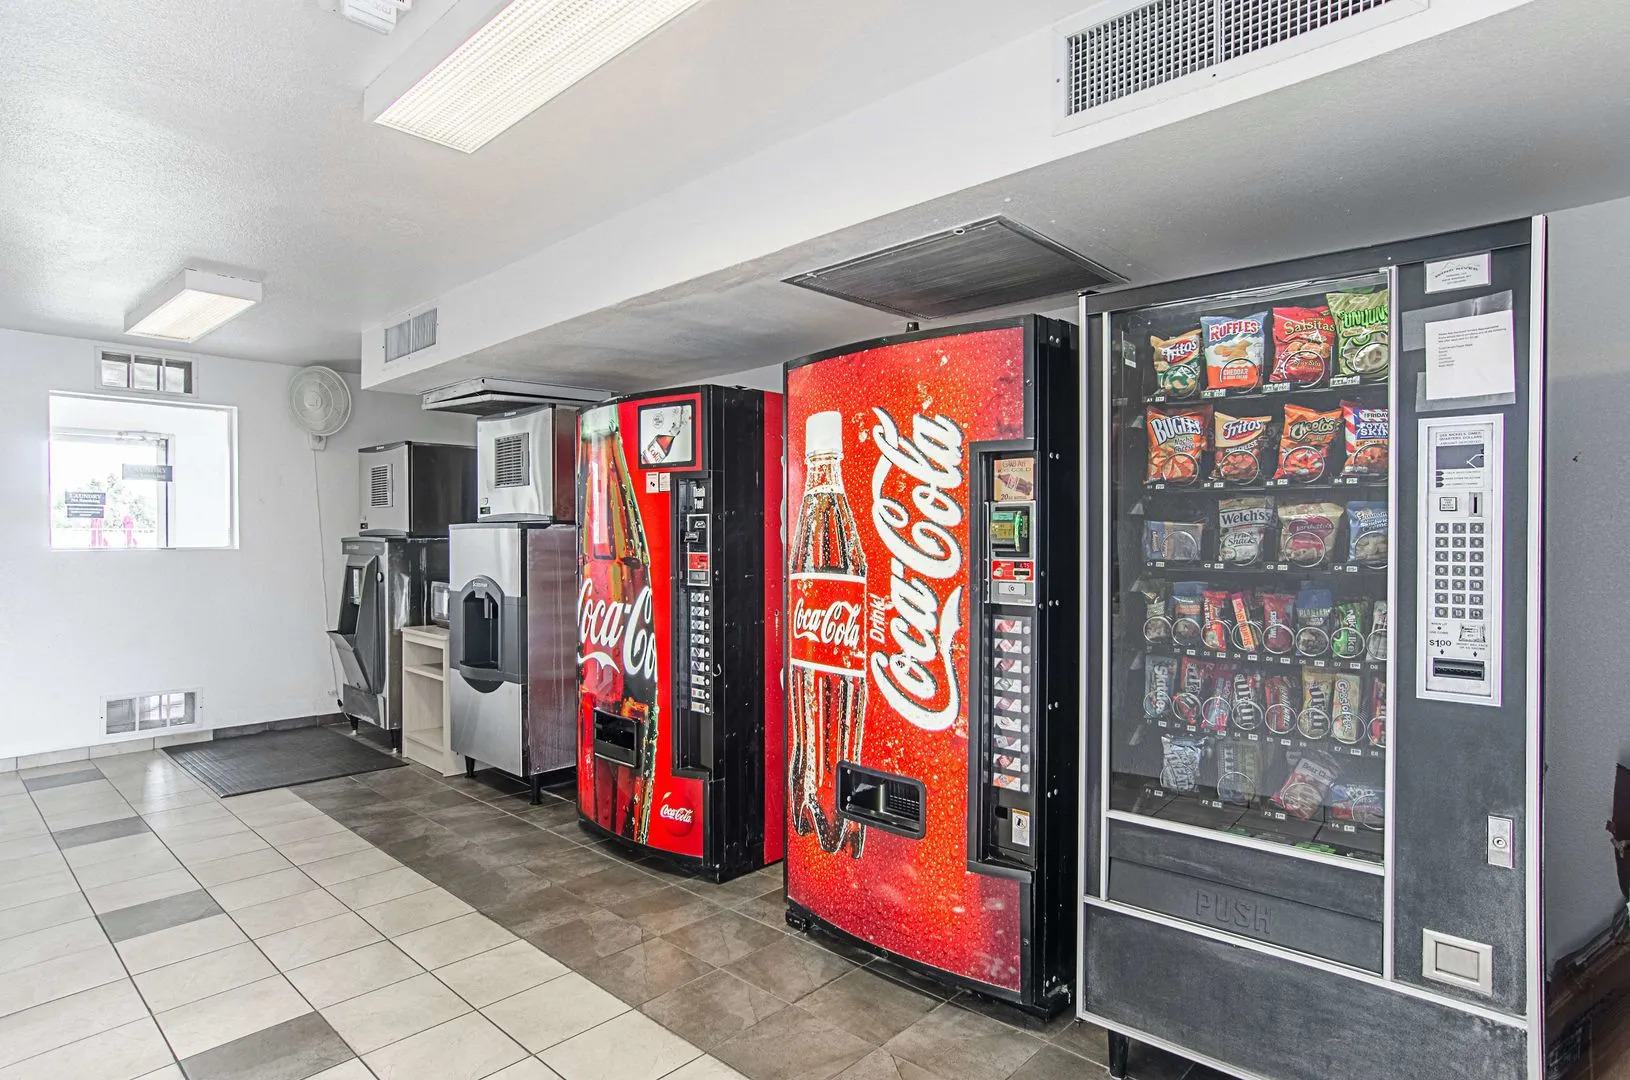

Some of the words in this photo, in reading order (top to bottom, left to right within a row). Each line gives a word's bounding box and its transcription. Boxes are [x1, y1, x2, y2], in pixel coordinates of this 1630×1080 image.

[1210, 320, 1259, 341] RUFFLES
[1283, 319, 1335, 335] Salsitas
[1162, 339, 1198, 361] Fritos
[1222, 420, 1261, 440] Fritos
[1290, 418, 1335, 441] Cheetos
[1222, 509, 1266, 525] Welch's
[871, 406, 965, 732] Coca-Cola
[793, 600, 861, 650] Coca-Cola
[869, 593, 886, 644] Drink!
[1429, 639, 1452, 648] $1.00
[1153, 663, 1169, 715] Skittles
[660, 803, 693, 824] Coca-Cola
[1195, 887, 1272, 936] PUSH
